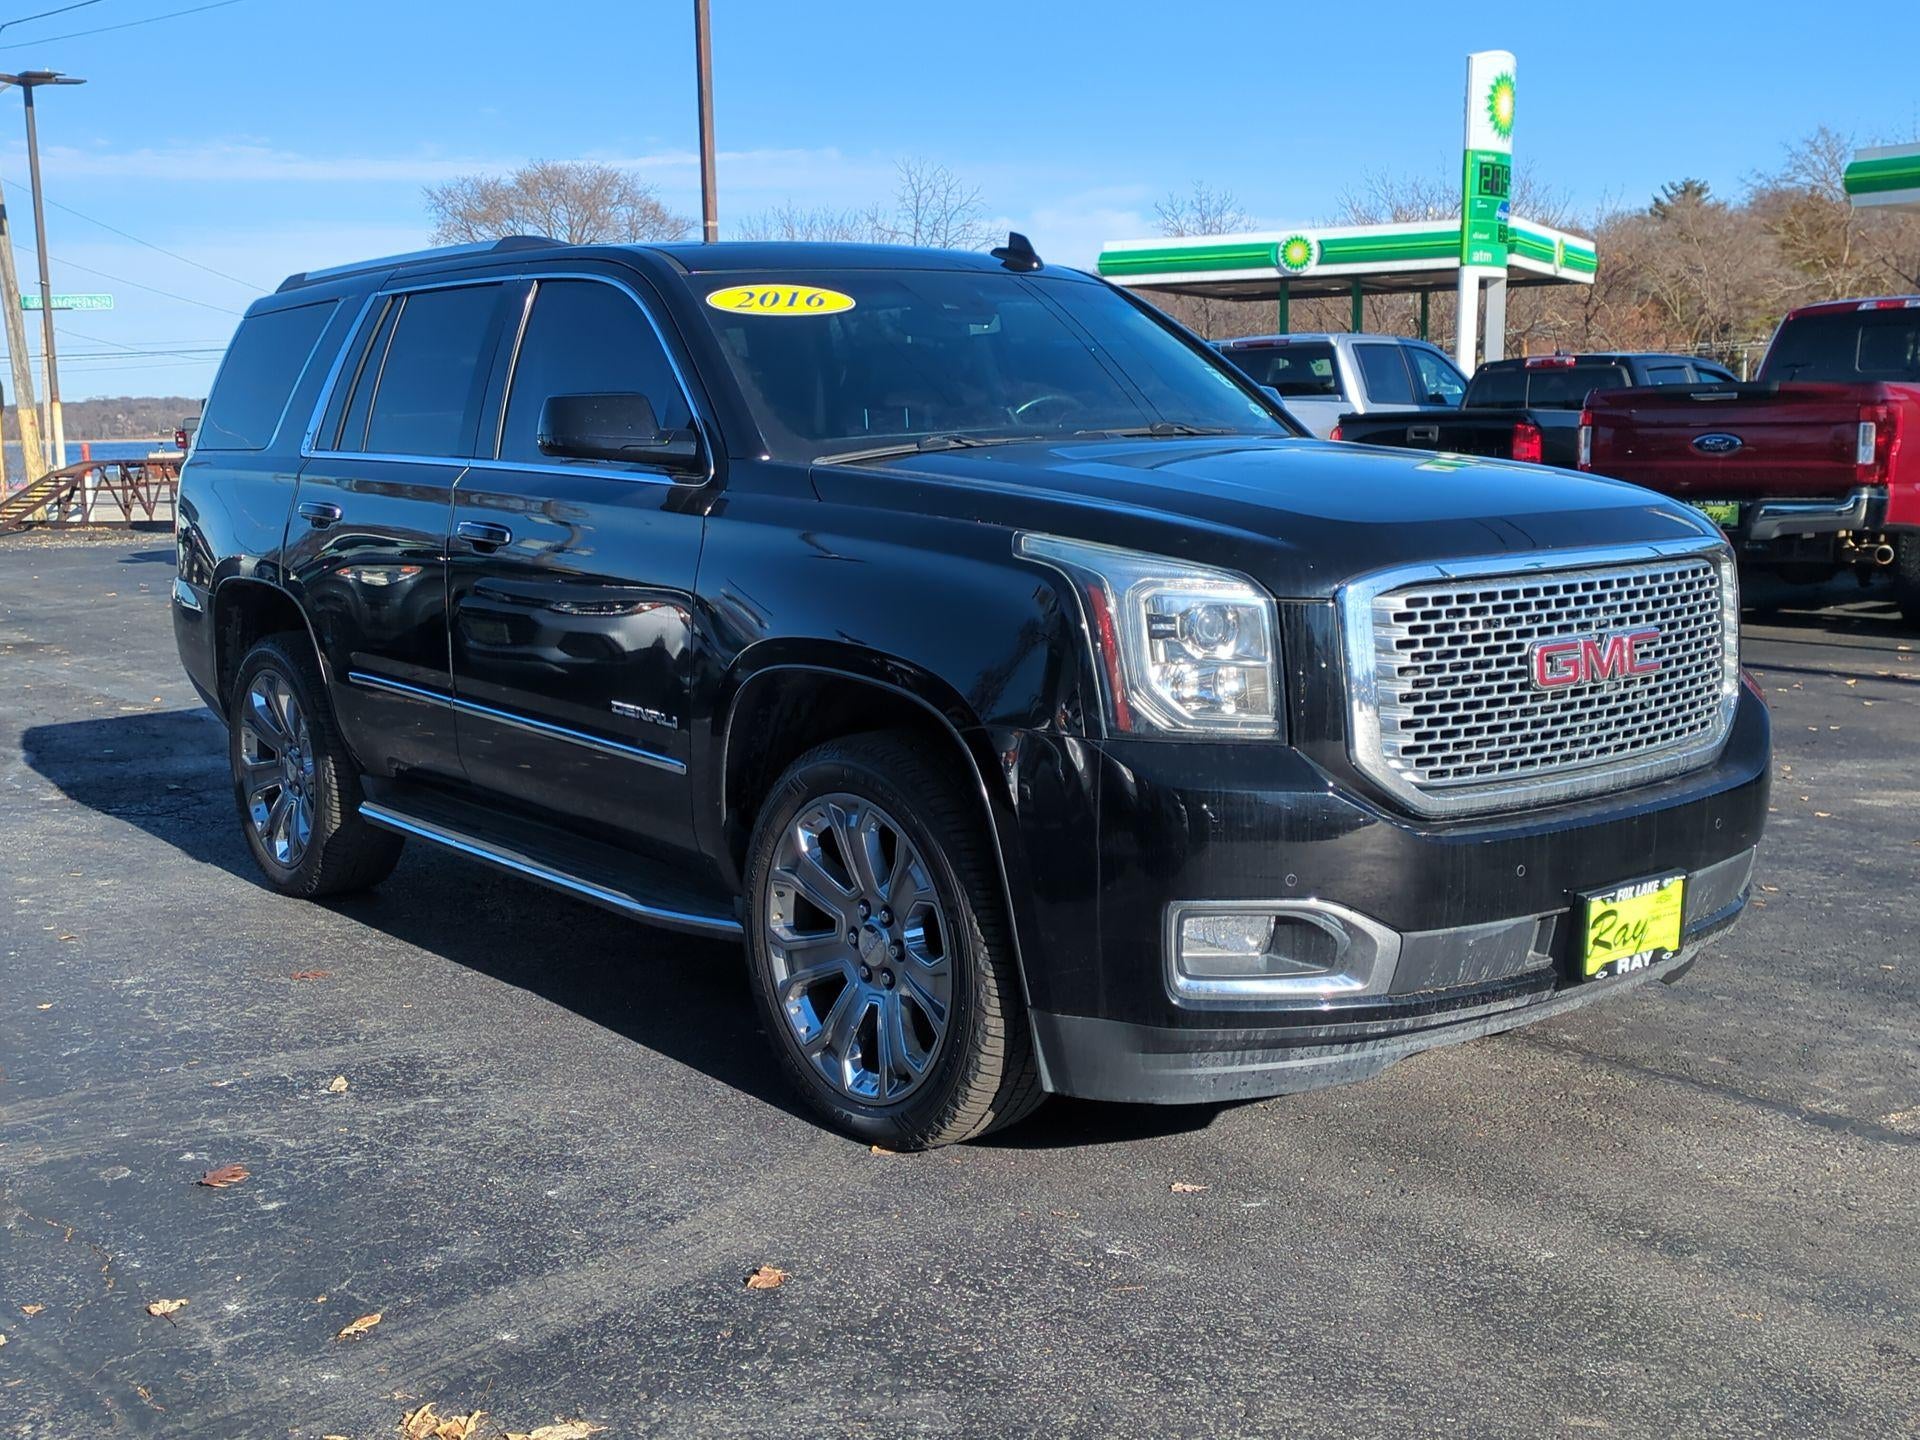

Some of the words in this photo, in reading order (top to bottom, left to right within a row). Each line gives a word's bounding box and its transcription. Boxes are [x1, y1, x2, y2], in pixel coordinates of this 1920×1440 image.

[1472, 250, 1492, 263] atm
[735, 291, 826, 309] 2016
[1531, 629, 1661, 689] GMC
[1616, 885, 1635, 903] FOX
[1635, 879, 1660, 897] LAKE
[1586, 909, 1649, 958] Ray
[1617, 950, 1654, 974] RAY
